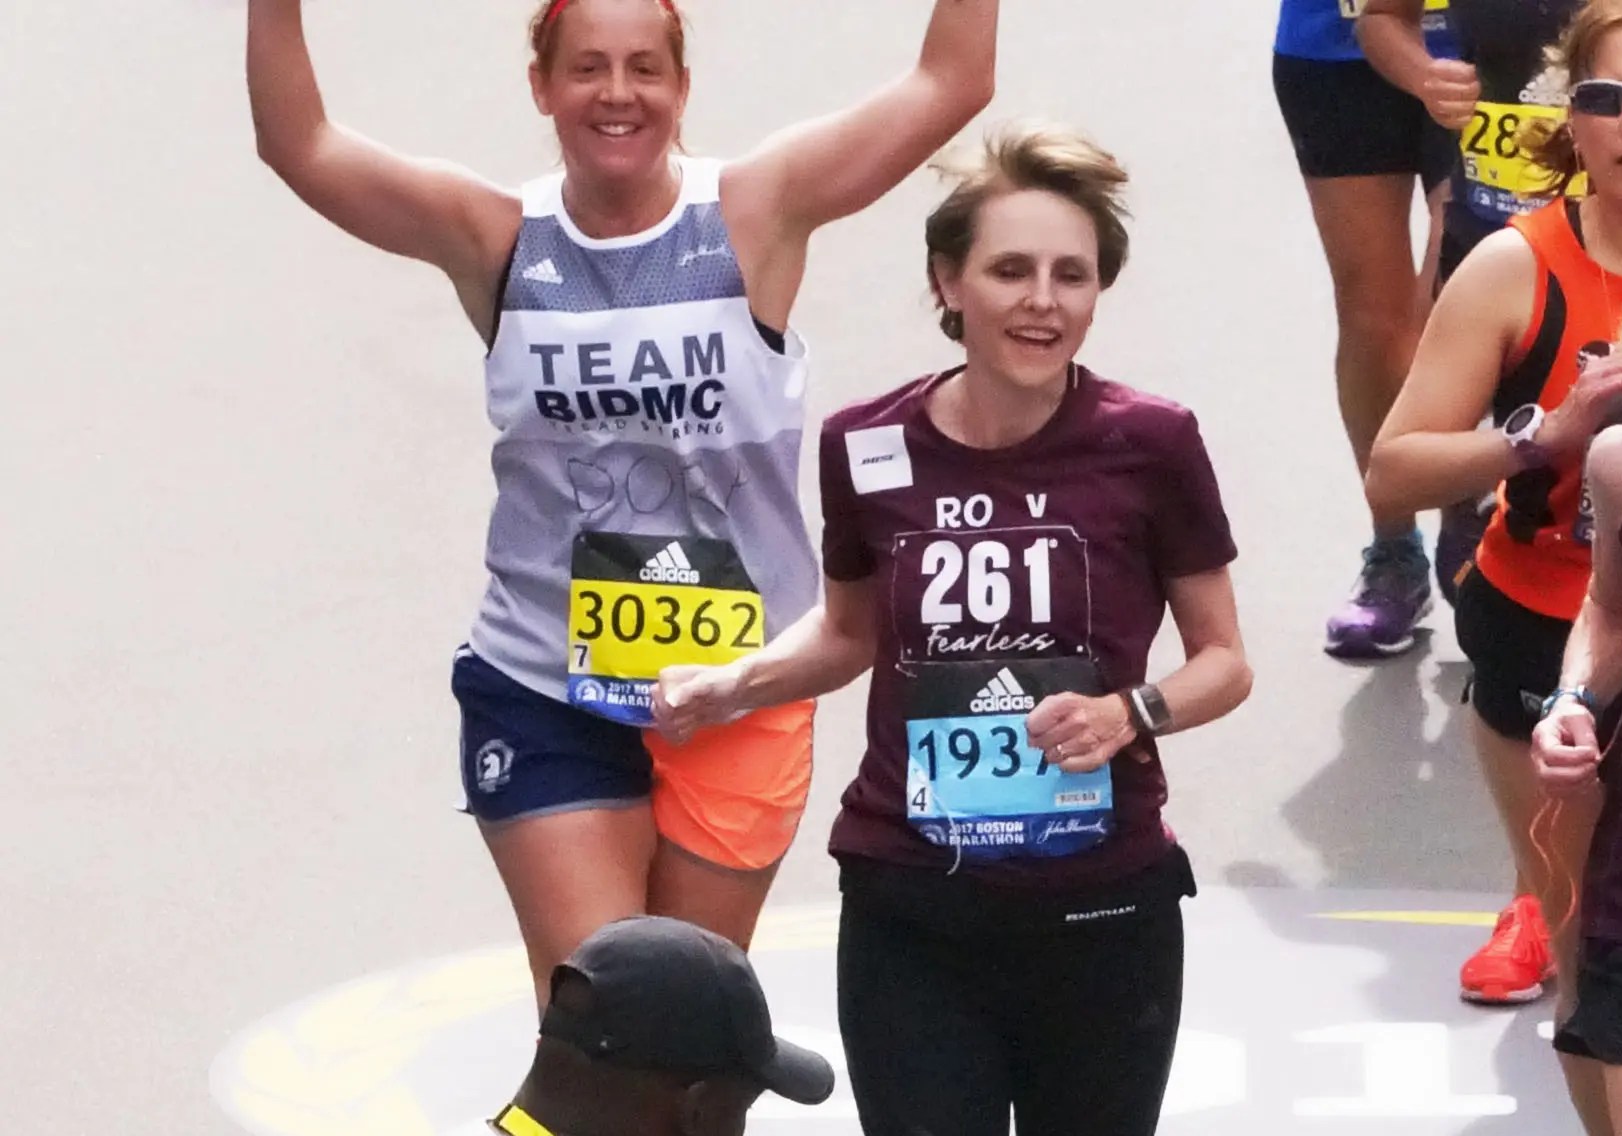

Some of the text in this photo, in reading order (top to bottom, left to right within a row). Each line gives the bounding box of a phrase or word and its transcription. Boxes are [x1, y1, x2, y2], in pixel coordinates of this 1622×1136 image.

[529, 332, 727, 386] TEAM
[533, 379, 726, 425] BIDMC
[639, 566, 700, 585] adidas
[920, 537, 1052, 624] 261
[576, 590, 761, 649] 30362
[926, 623, 1055, 657] Fearless
[573, 645, 589, 668] 7
[606, 693, 651, 707] MARAT
[970, 694, 1036, 713] adidas
[911, 786, 928, 812] 4
[976, 820, 1024, 833] BOSTON
[949, 833, 1025, 846] MARATHON
